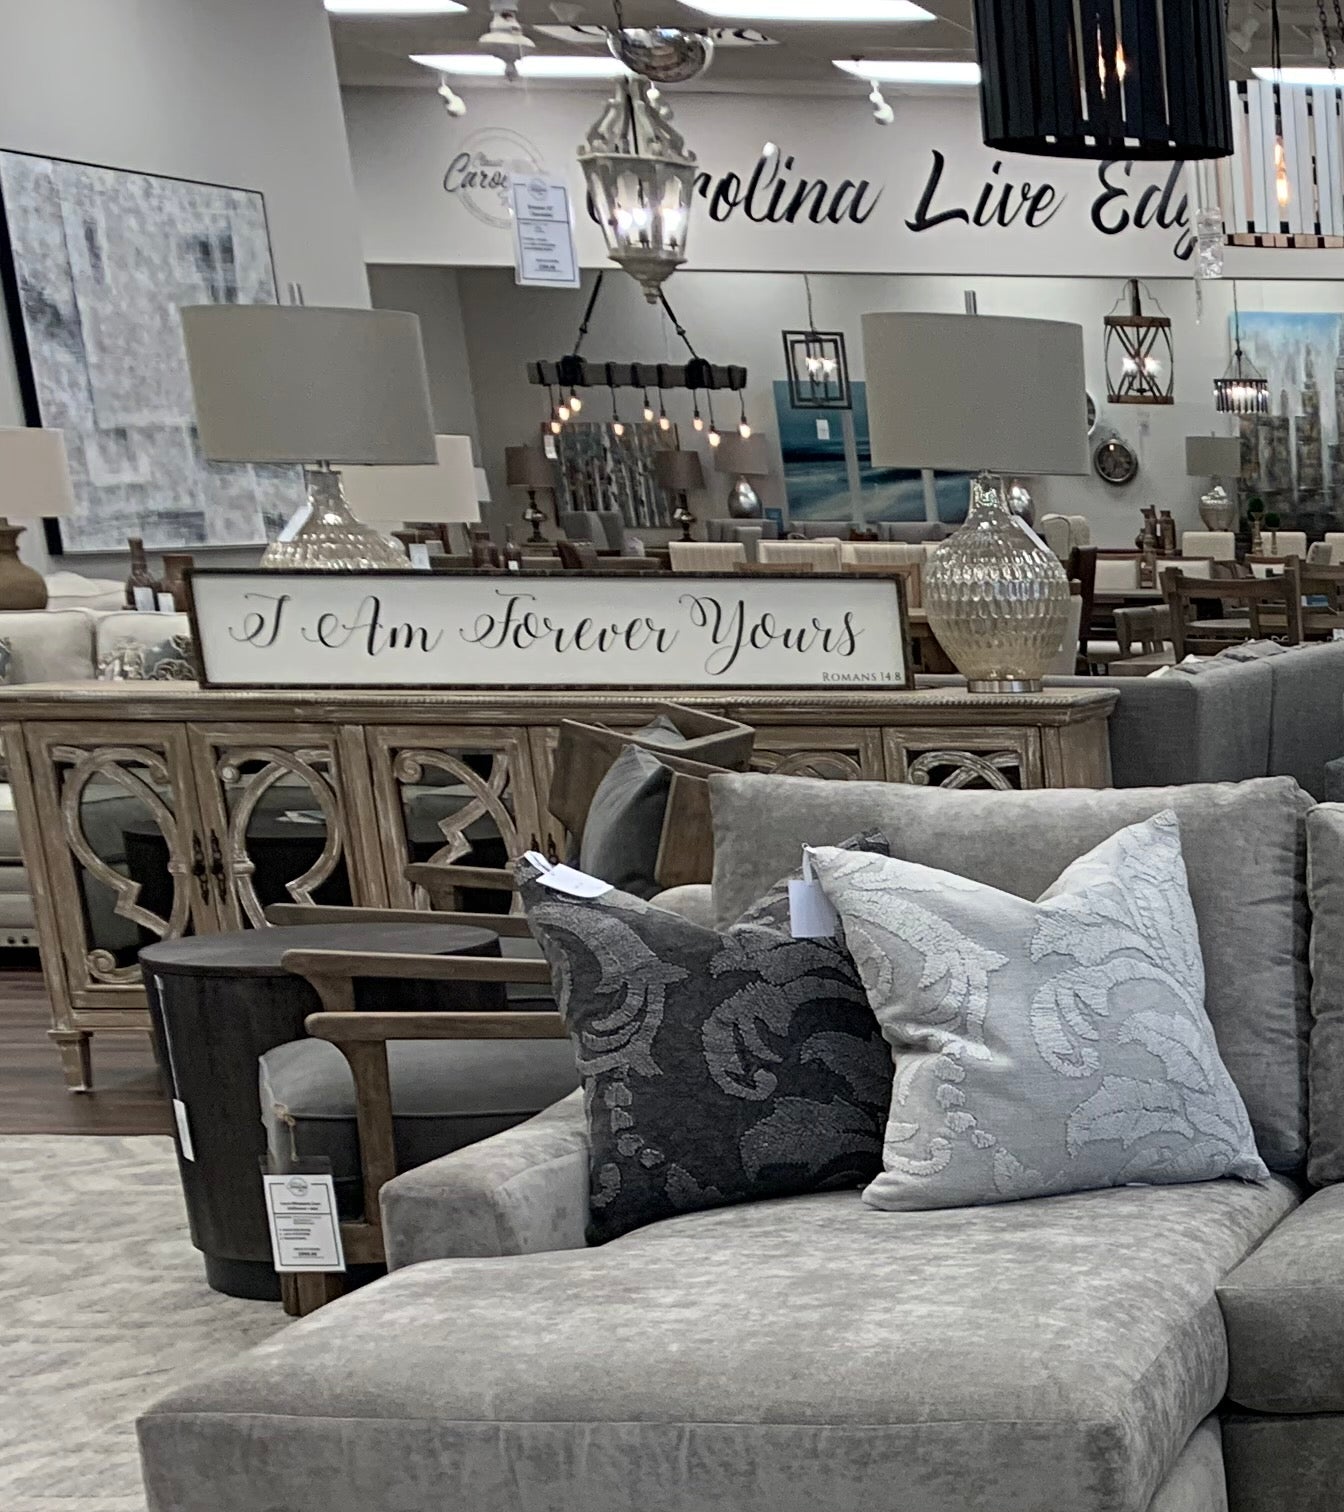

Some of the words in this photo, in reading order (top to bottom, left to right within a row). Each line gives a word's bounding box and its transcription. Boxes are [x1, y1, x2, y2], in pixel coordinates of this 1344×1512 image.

[905, 150, 1065, 232] Live
[301, 594, 444, 656] Am
[459, 588, 679, 654] Forever
[678, 593, 865, 676] Yours
[822, 671, 877, 682] ROMANS
[879, 671, 902, 681] 148
